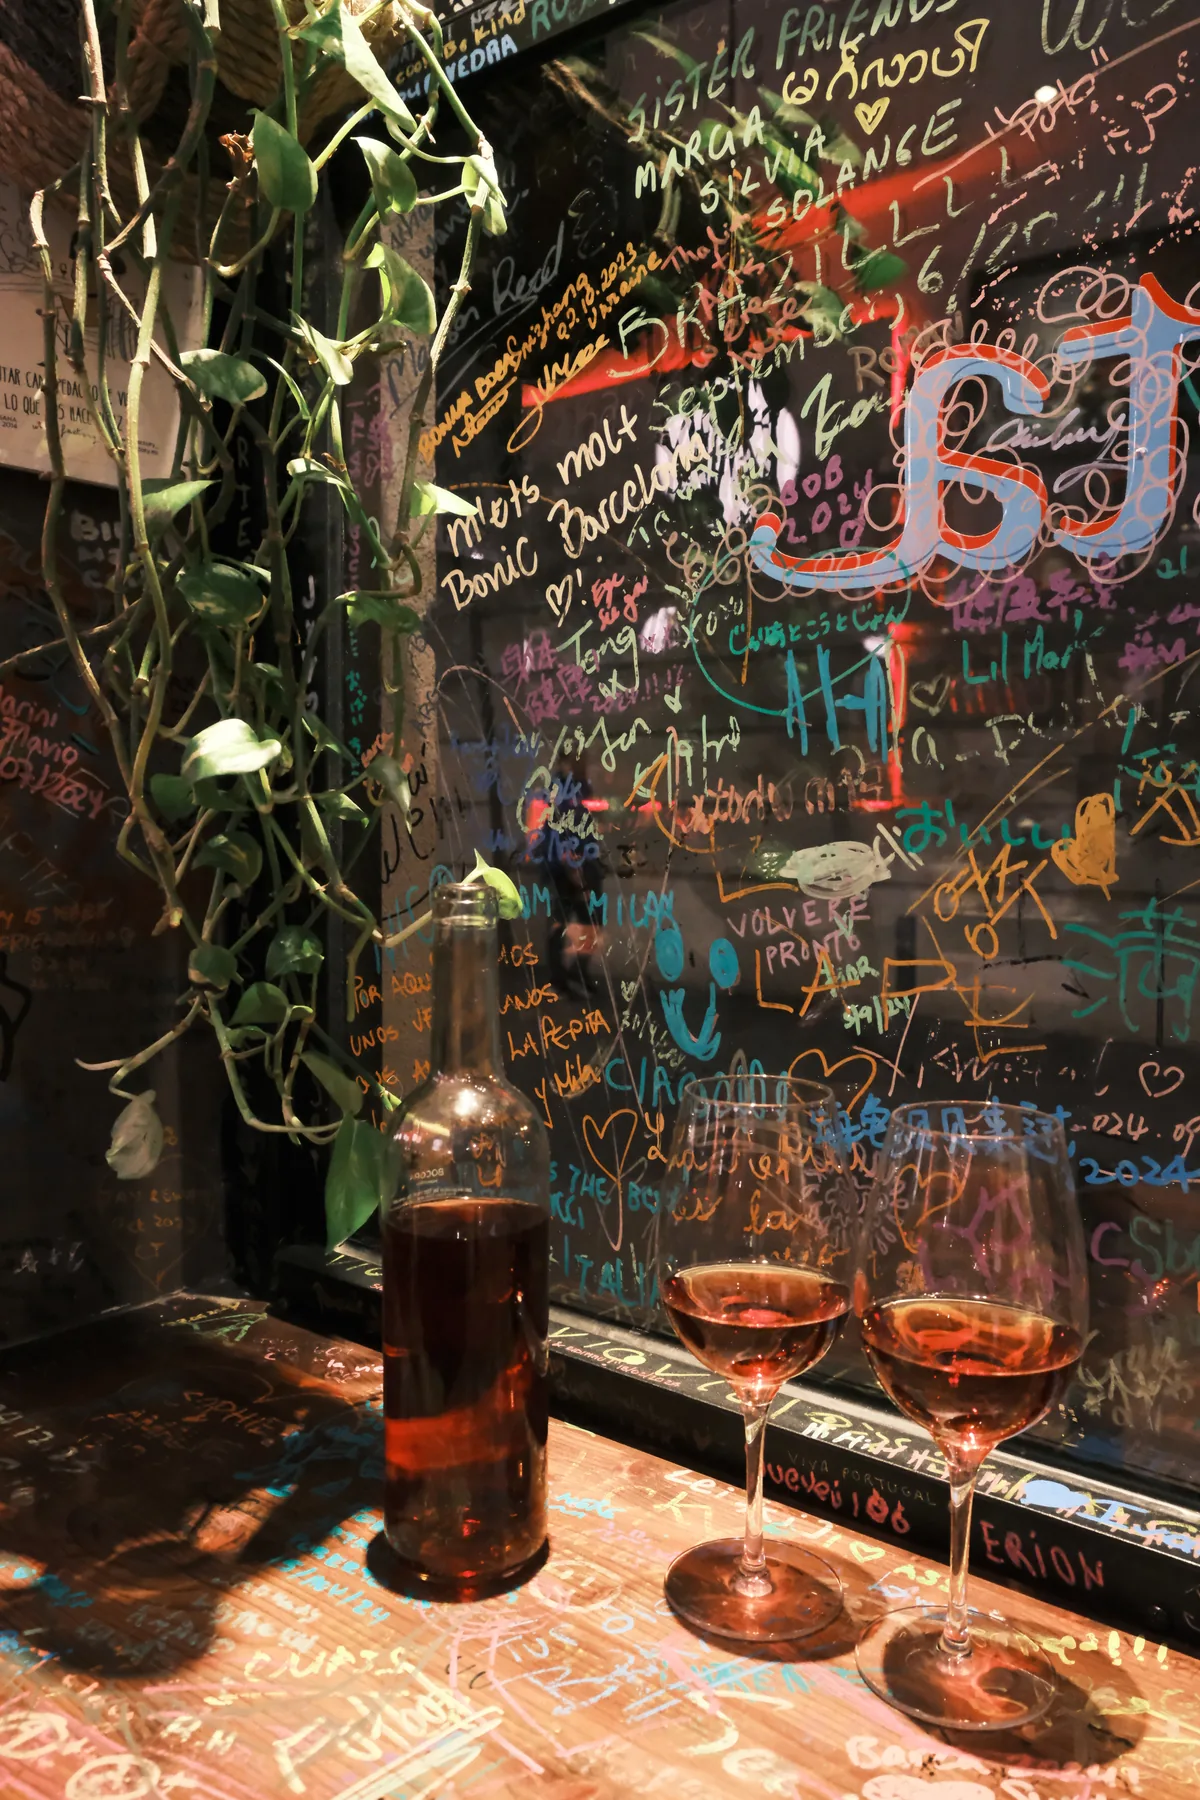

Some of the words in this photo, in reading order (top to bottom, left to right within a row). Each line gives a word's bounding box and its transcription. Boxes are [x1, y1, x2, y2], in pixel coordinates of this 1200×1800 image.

[350, 1025, 399, 1057] UNOS
[787, 1450, 830, 1473] VIVA
[842, 1466, 938, 1507] PORTUGAL
